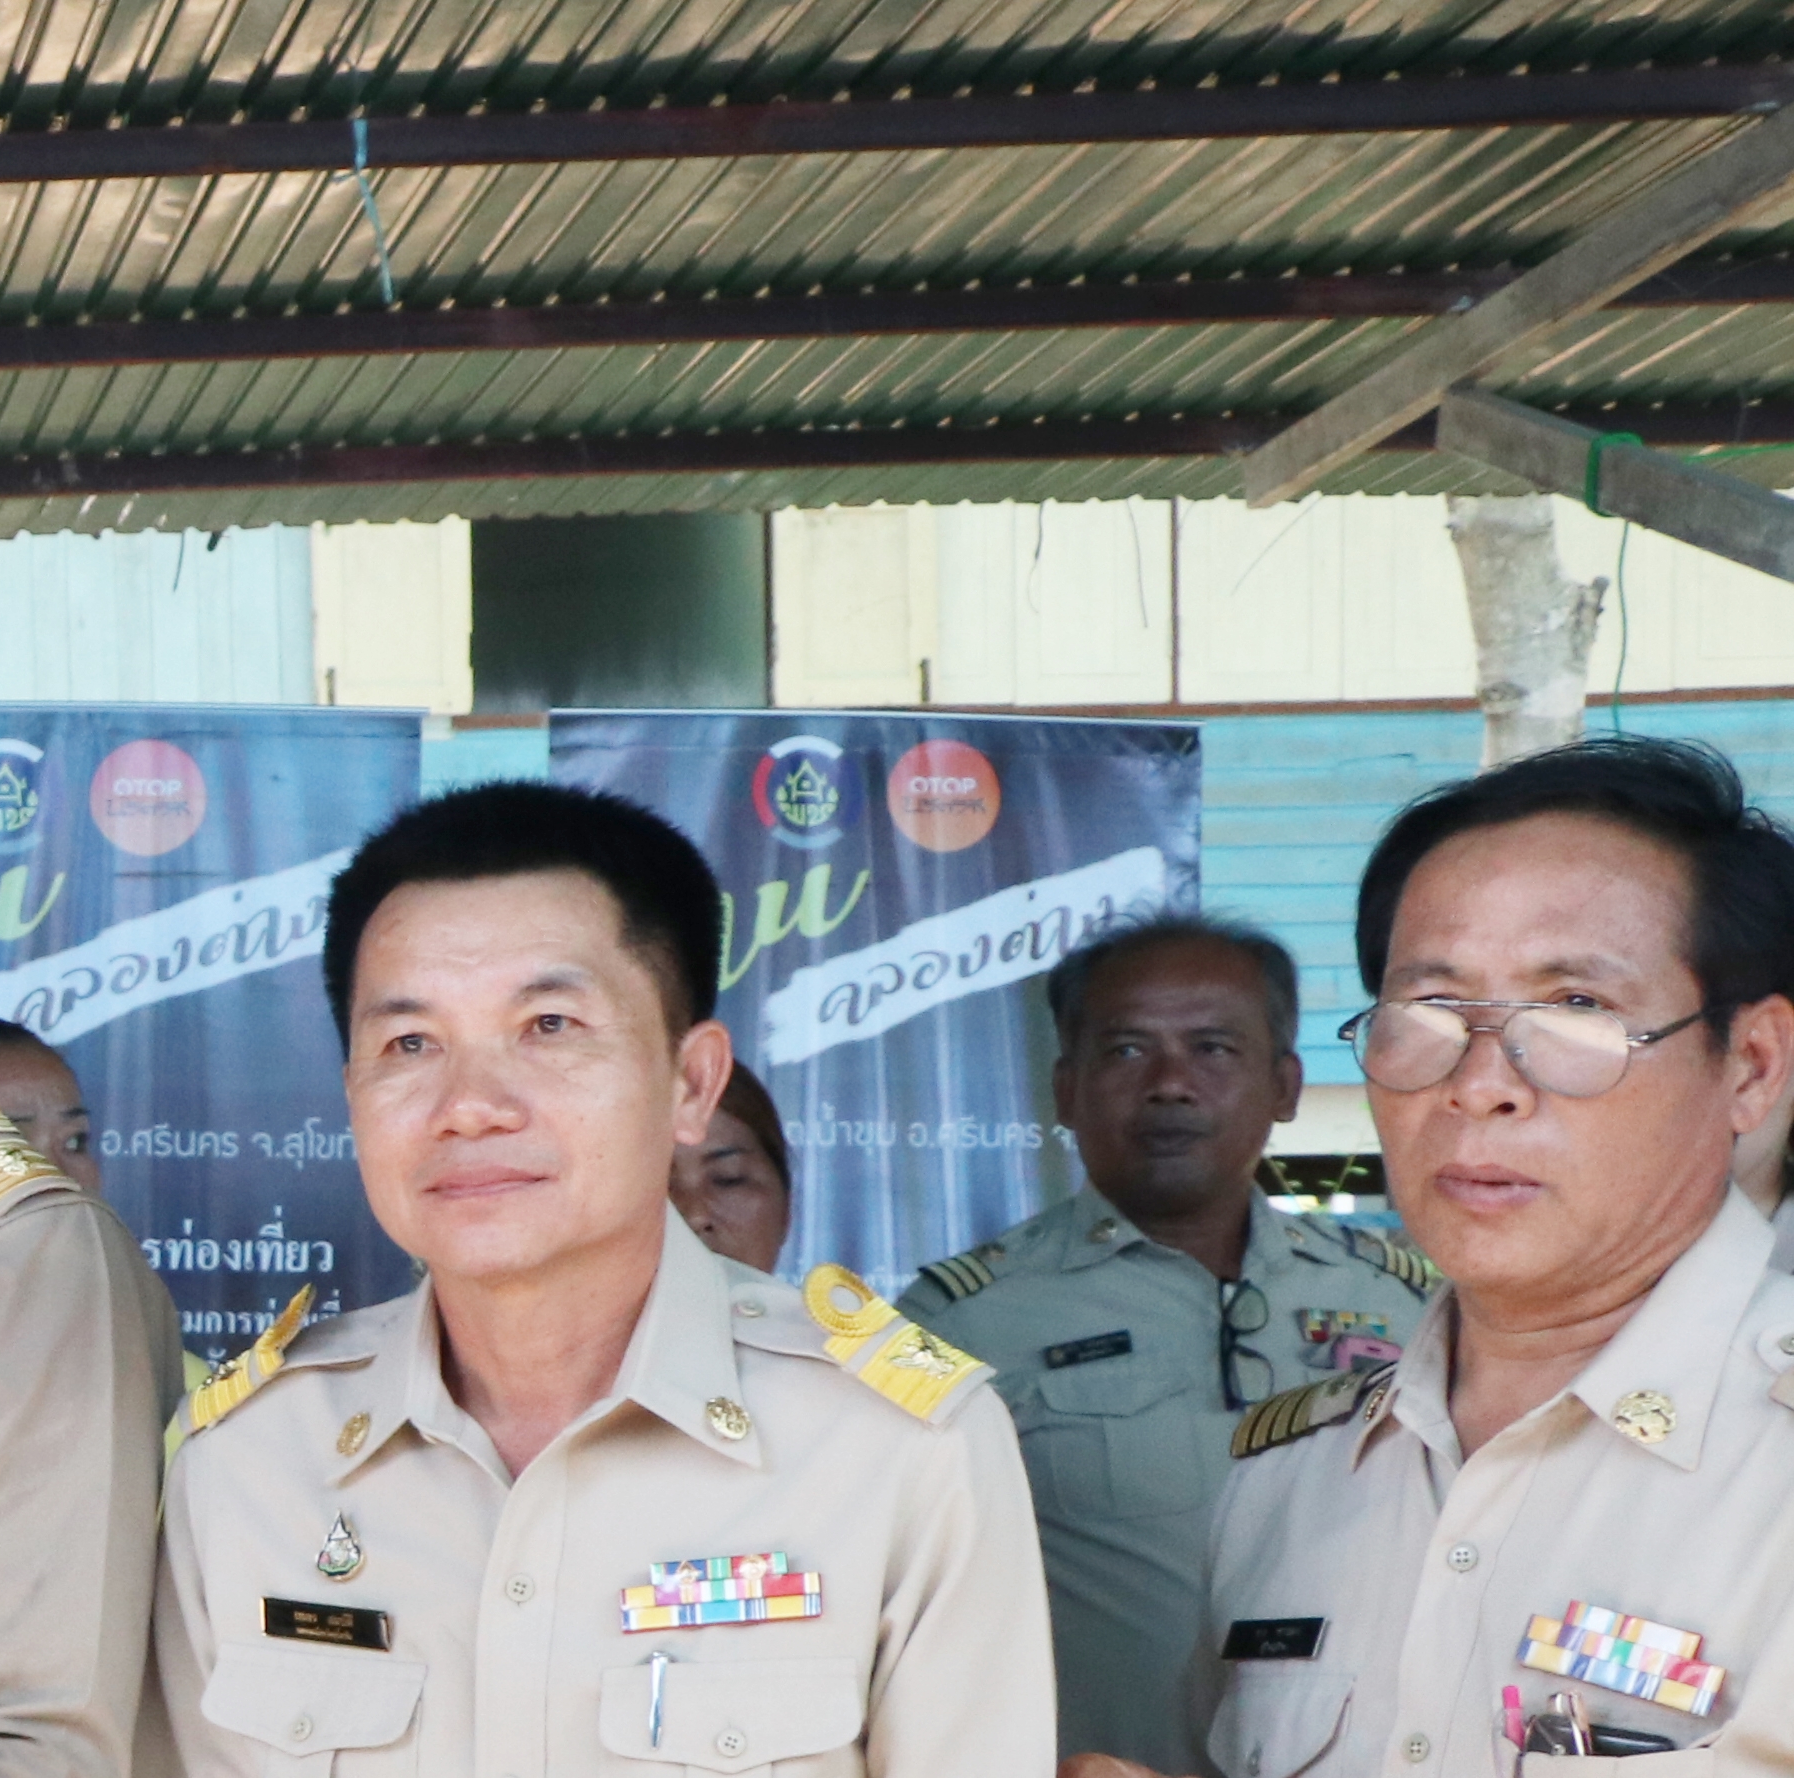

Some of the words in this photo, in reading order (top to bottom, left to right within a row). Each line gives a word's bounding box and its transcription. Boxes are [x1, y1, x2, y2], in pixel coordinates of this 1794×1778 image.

[113, 778, 184, 796] OTOP
[908, 776, 978, 794] OTOP
[250, 1116, 357, 1171] จ.สุโขท
